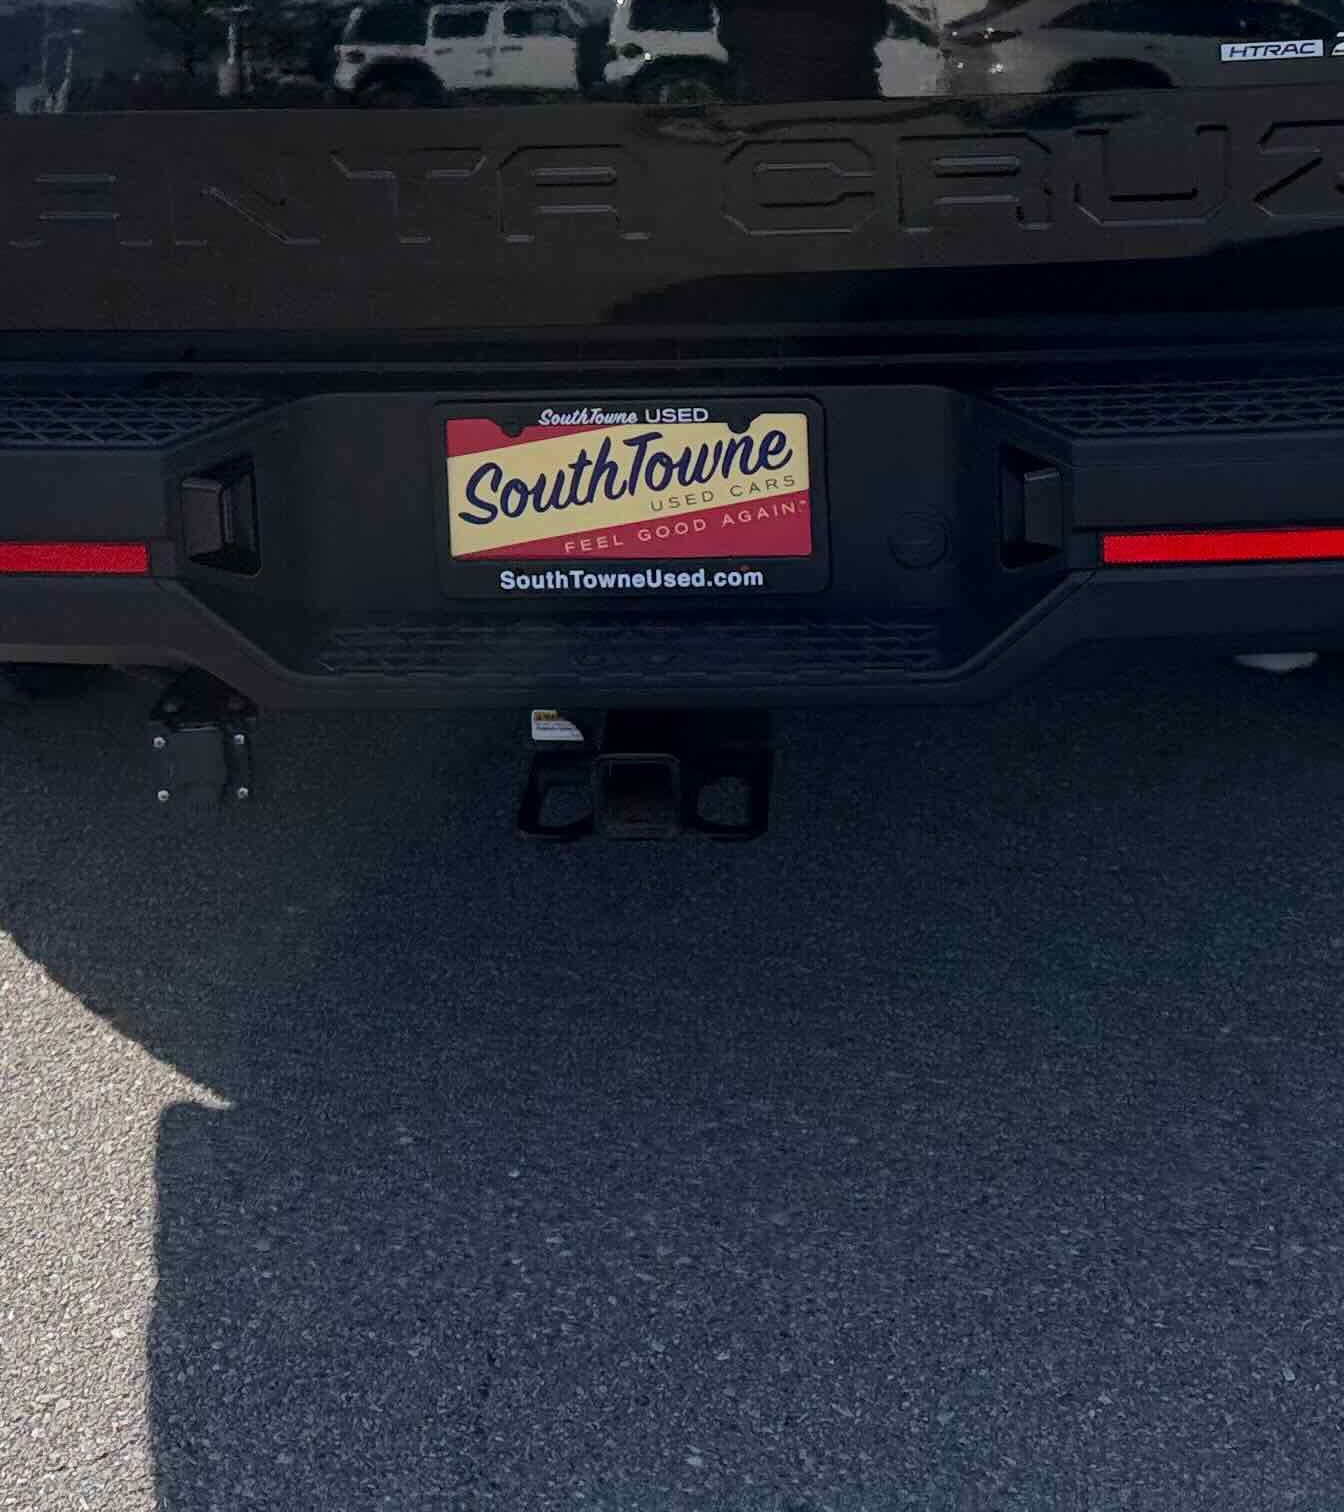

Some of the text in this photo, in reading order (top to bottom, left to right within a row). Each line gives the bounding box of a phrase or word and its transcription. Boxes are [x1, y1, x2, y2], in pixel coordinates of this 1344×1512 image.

[1228, 41, 1316, 58] HTRAC
[537, 407, 709, 426] SouthTowne USED
[457, 429, 794, 525] SouthTowne
[650, 475, 796, 512] USED CARS
[563, 534, 625, 554] FEEL
[637, 518, 707, 542] GOOD
[499, 567, 765, 591] SouthTowneUsed.com
